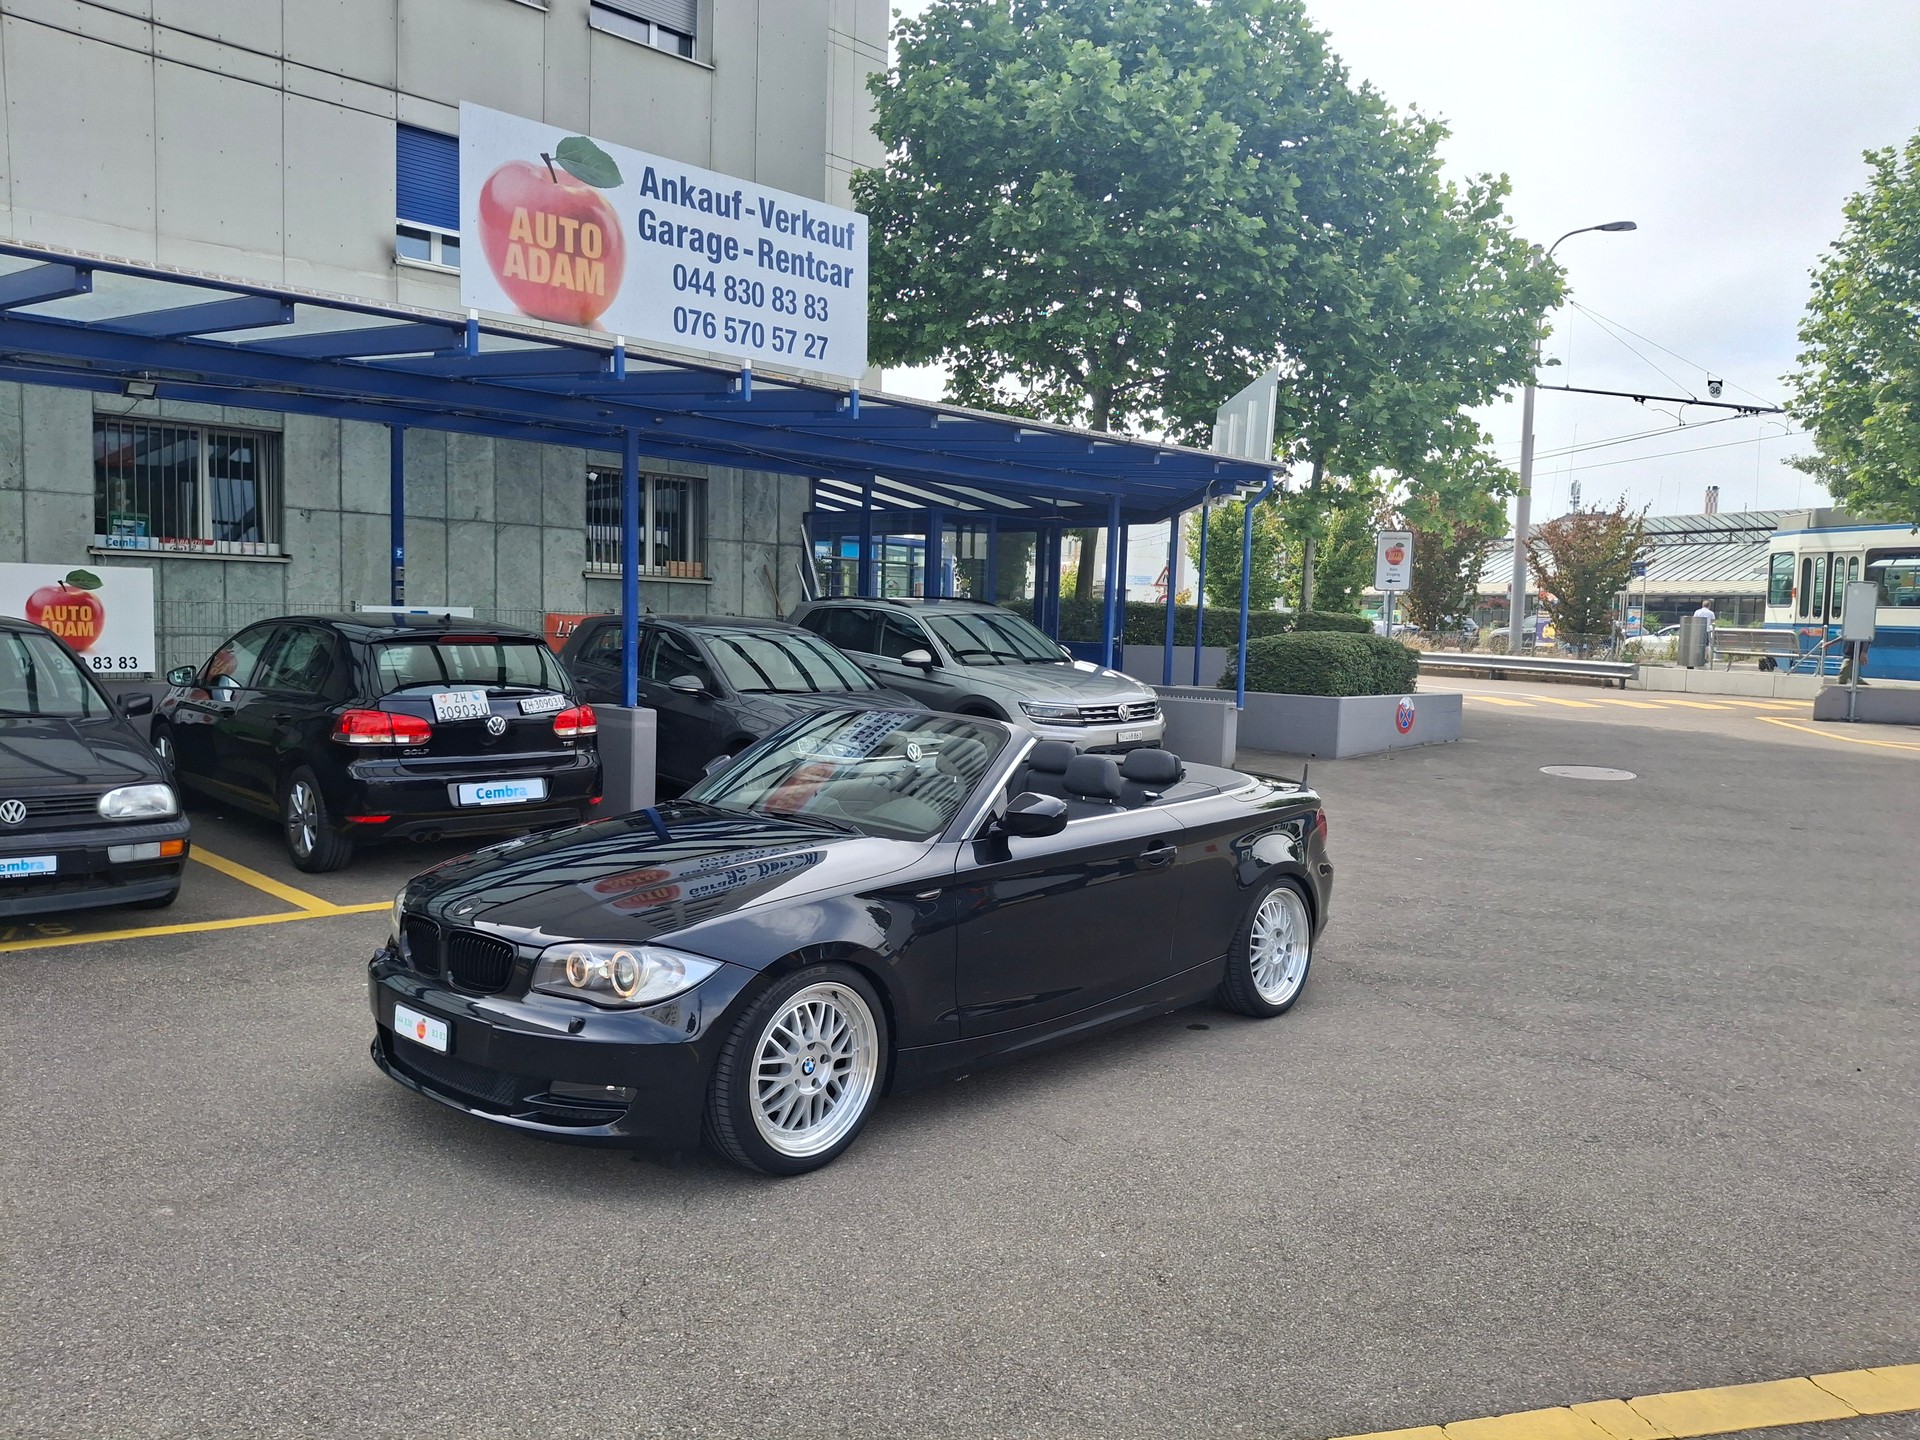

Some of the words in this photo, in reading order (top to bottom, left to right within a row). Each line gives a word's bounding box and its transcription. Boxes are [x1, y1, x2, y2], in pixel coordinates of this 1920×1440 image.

[508, 206, 603, 260] AUTO
[503, 246, 605, 297] ADAM
[672, 263, 717, 298] 044
[723, 275, 765, 308] 830
[771, 287, 797, 316] 83
[803, 294, 829, 322] 83
[672, 305, 717, 339] 076
[723, 317, 765, 349] 570
[771, 328, 797, 354] 57
[803, 333, 829, 360] 27
[105, 537, 146, 548] Cembra
[41, 605, 92, 621] AUTO
[92, 656, 112, 669] 83
[118, 656, 138, 669] 83
[453, 693, 467, 703] ZH
[403, 748, 430, 756] GOLF
[476, 785, 528, 799] Cembra
[0, 860, 45, 871] embra
